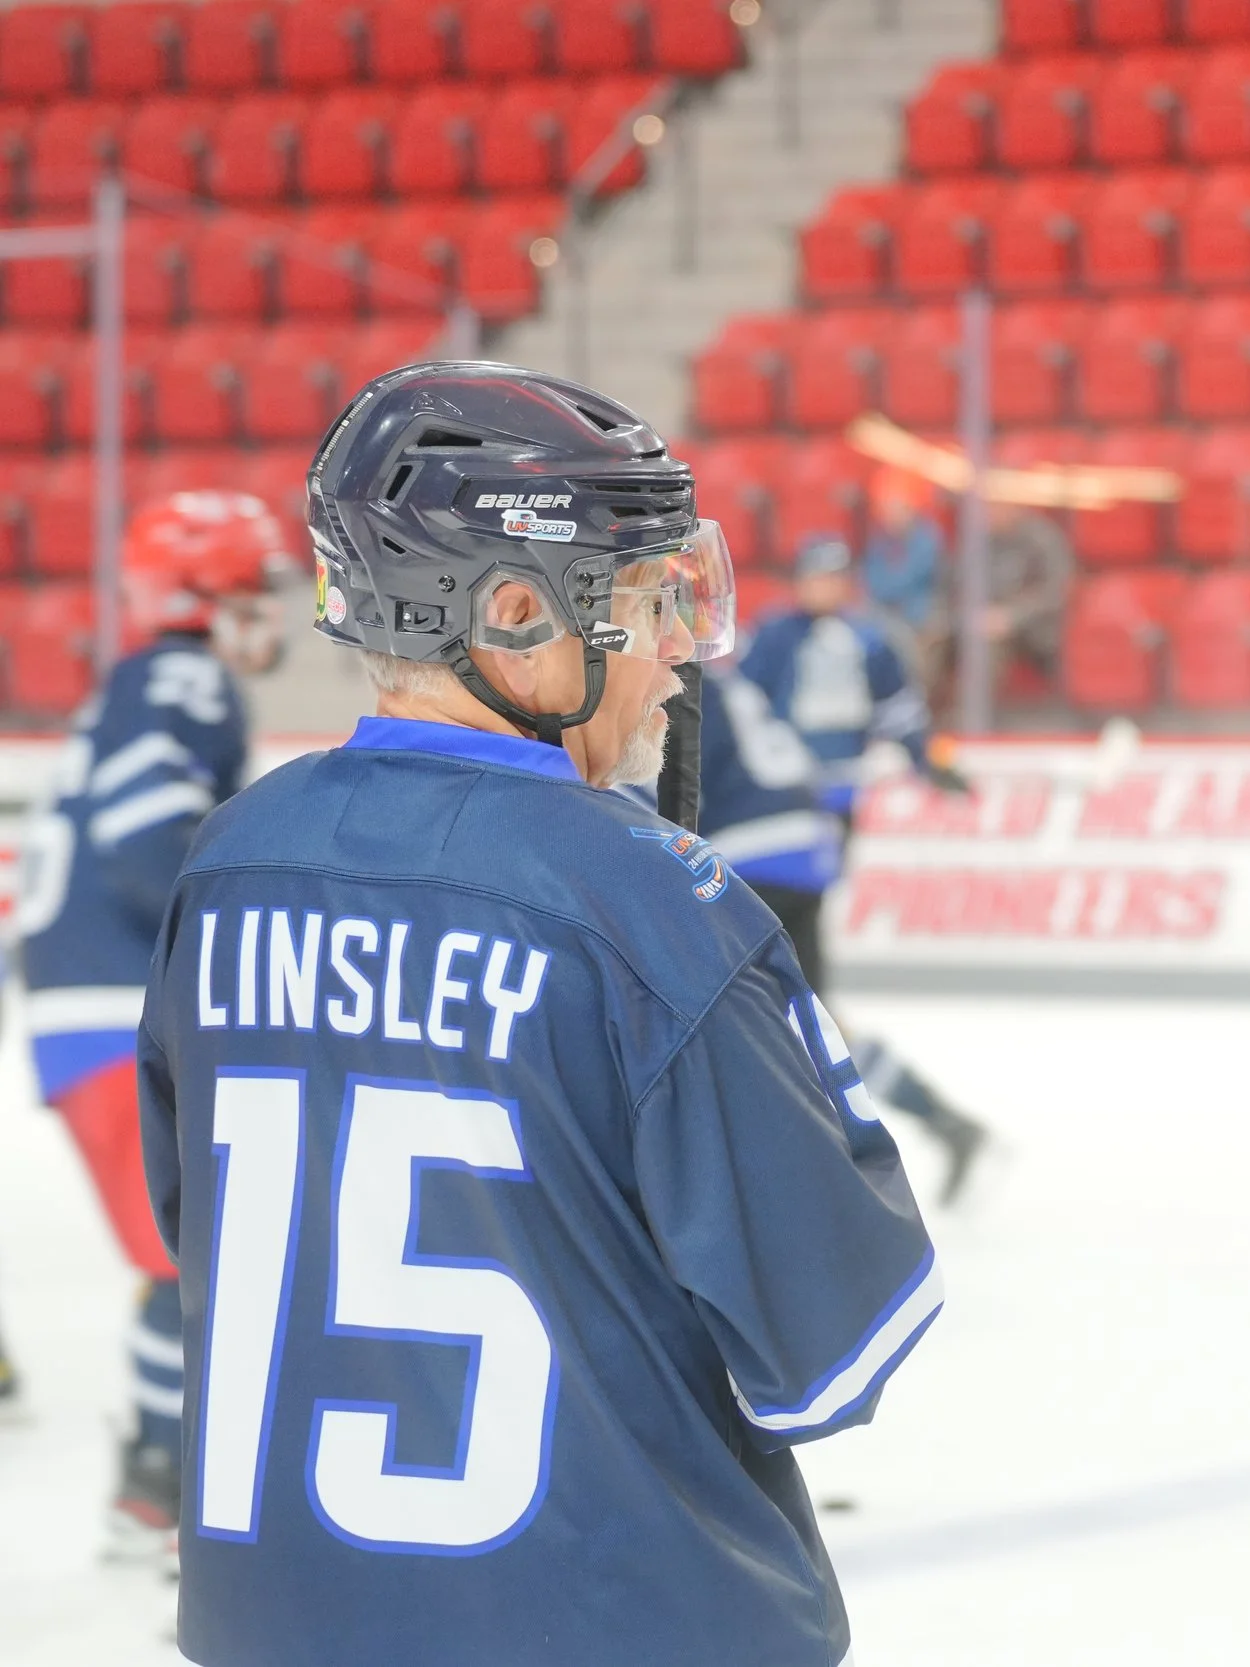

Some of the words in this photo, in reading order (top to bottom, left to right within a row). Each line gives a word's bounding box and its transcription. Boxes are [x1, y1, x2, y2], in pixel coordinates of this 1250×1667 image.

[590, 634, 627, 645] CCM
[197, 907, 554, 1062] LINSLEY
[196, 1066, 561, 1558] 15
